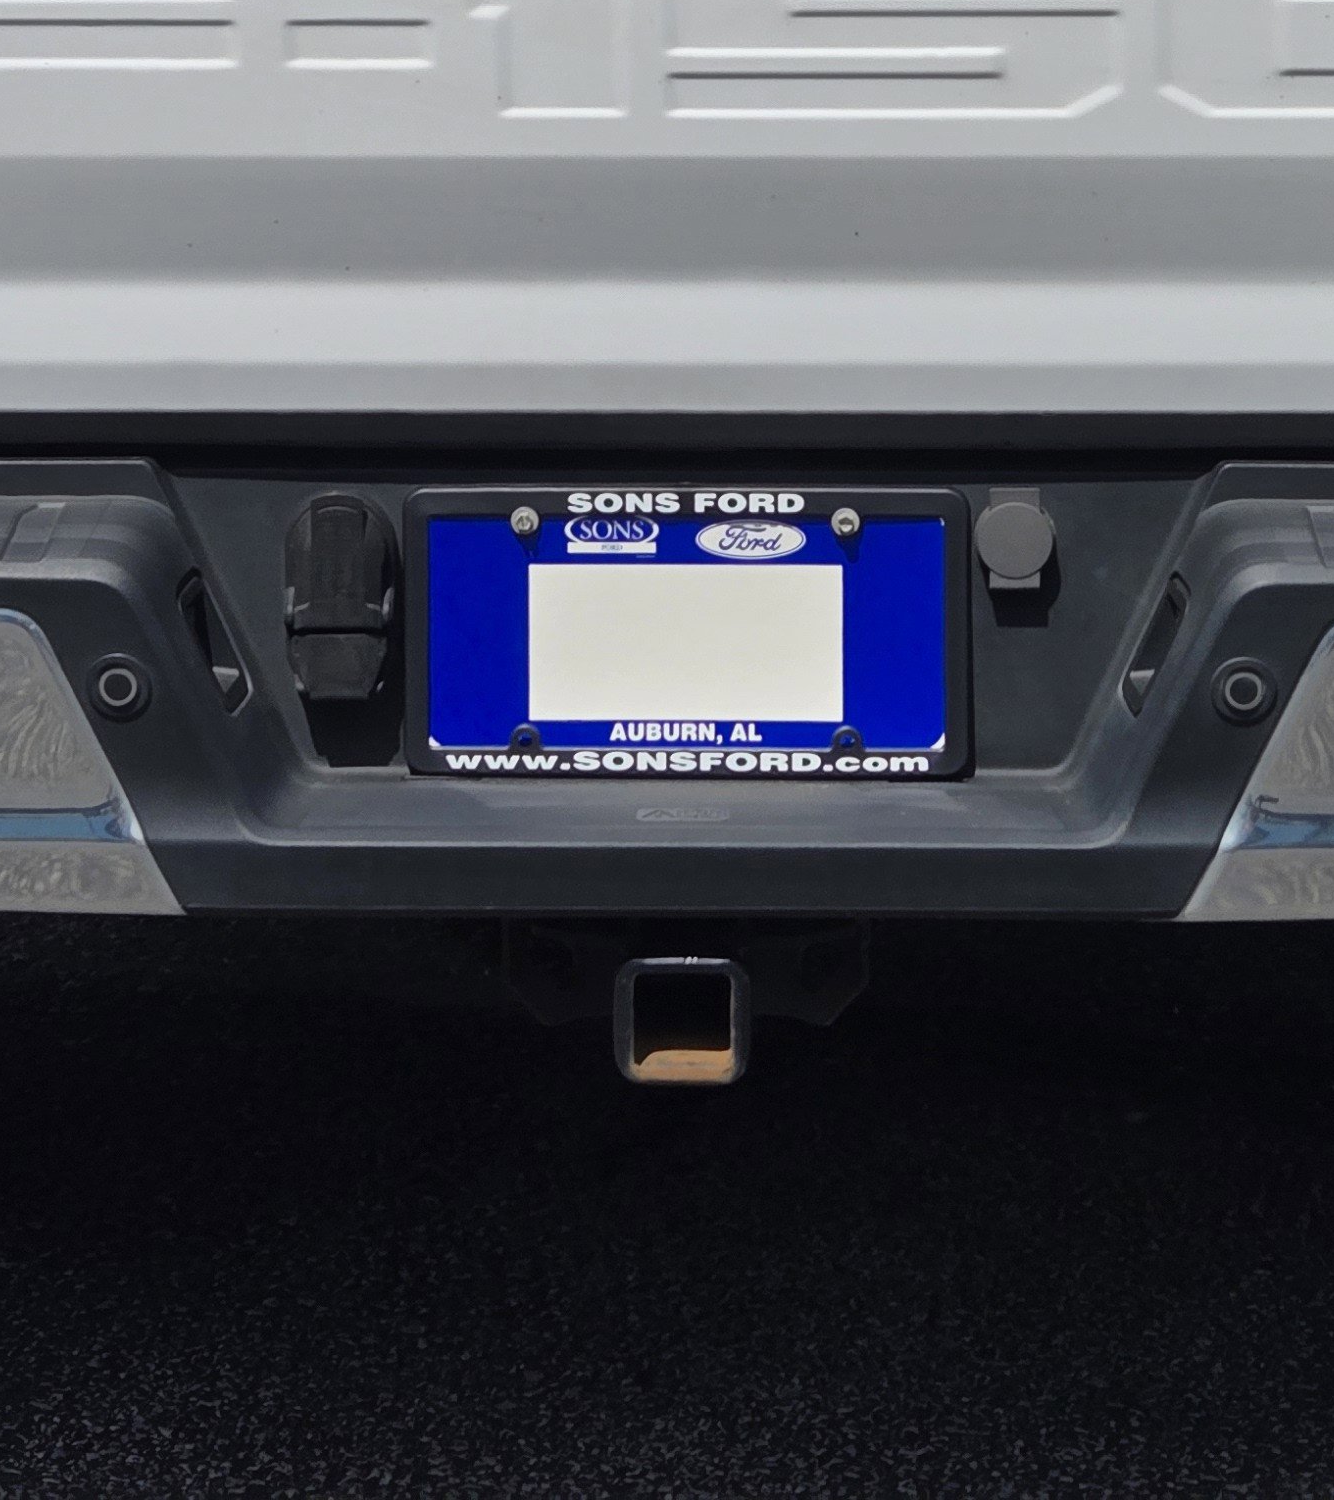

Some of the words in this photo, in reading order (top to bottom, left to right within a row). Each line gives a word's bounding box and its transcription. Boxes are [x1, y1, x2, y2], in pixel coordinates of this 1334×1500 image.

[567, 492, 681, 514] SONS
[694, 492, 805, 514] FORD
[579, 519, 646, 540] SONS
[717, 524, 784, 552] Ford
[609, 722, 724, 745] AUBURN,
[730, 722, 763, 743] AL
[445, 749, 930, 774] www.SONSFORD.com
